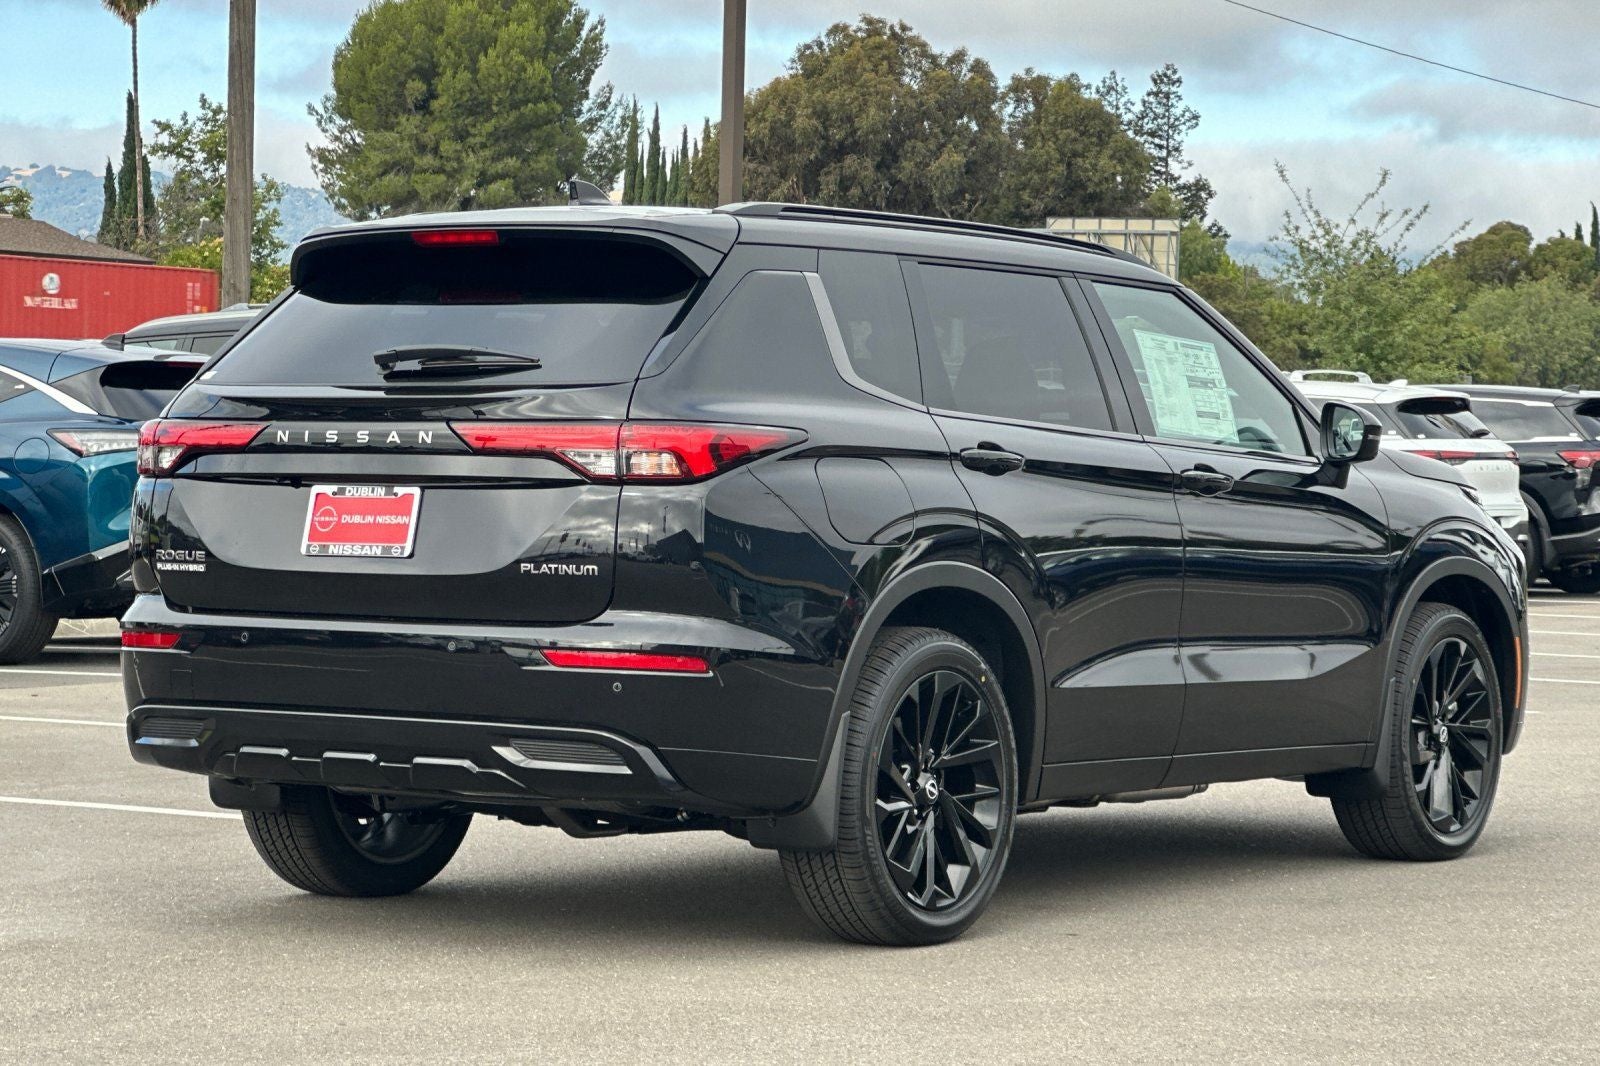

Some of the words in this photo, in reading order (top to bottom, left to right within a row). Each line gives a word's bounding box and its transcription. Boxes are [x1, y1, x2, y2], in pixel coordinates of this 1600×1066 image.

[276, 430, 433, 444] NISSAN
[345, 487, 386, 497] DUBLIN
[341, 514, 375, 524] DUBLIN
[375, 515, 410, 525] NISSAN
[155, 549, 206, 561] ROGUE
[328, 545, 382, 555] NISSAN
[179, 564, 206, 572] HYBRID
[520, 563, 598, 576] PLATINUM
